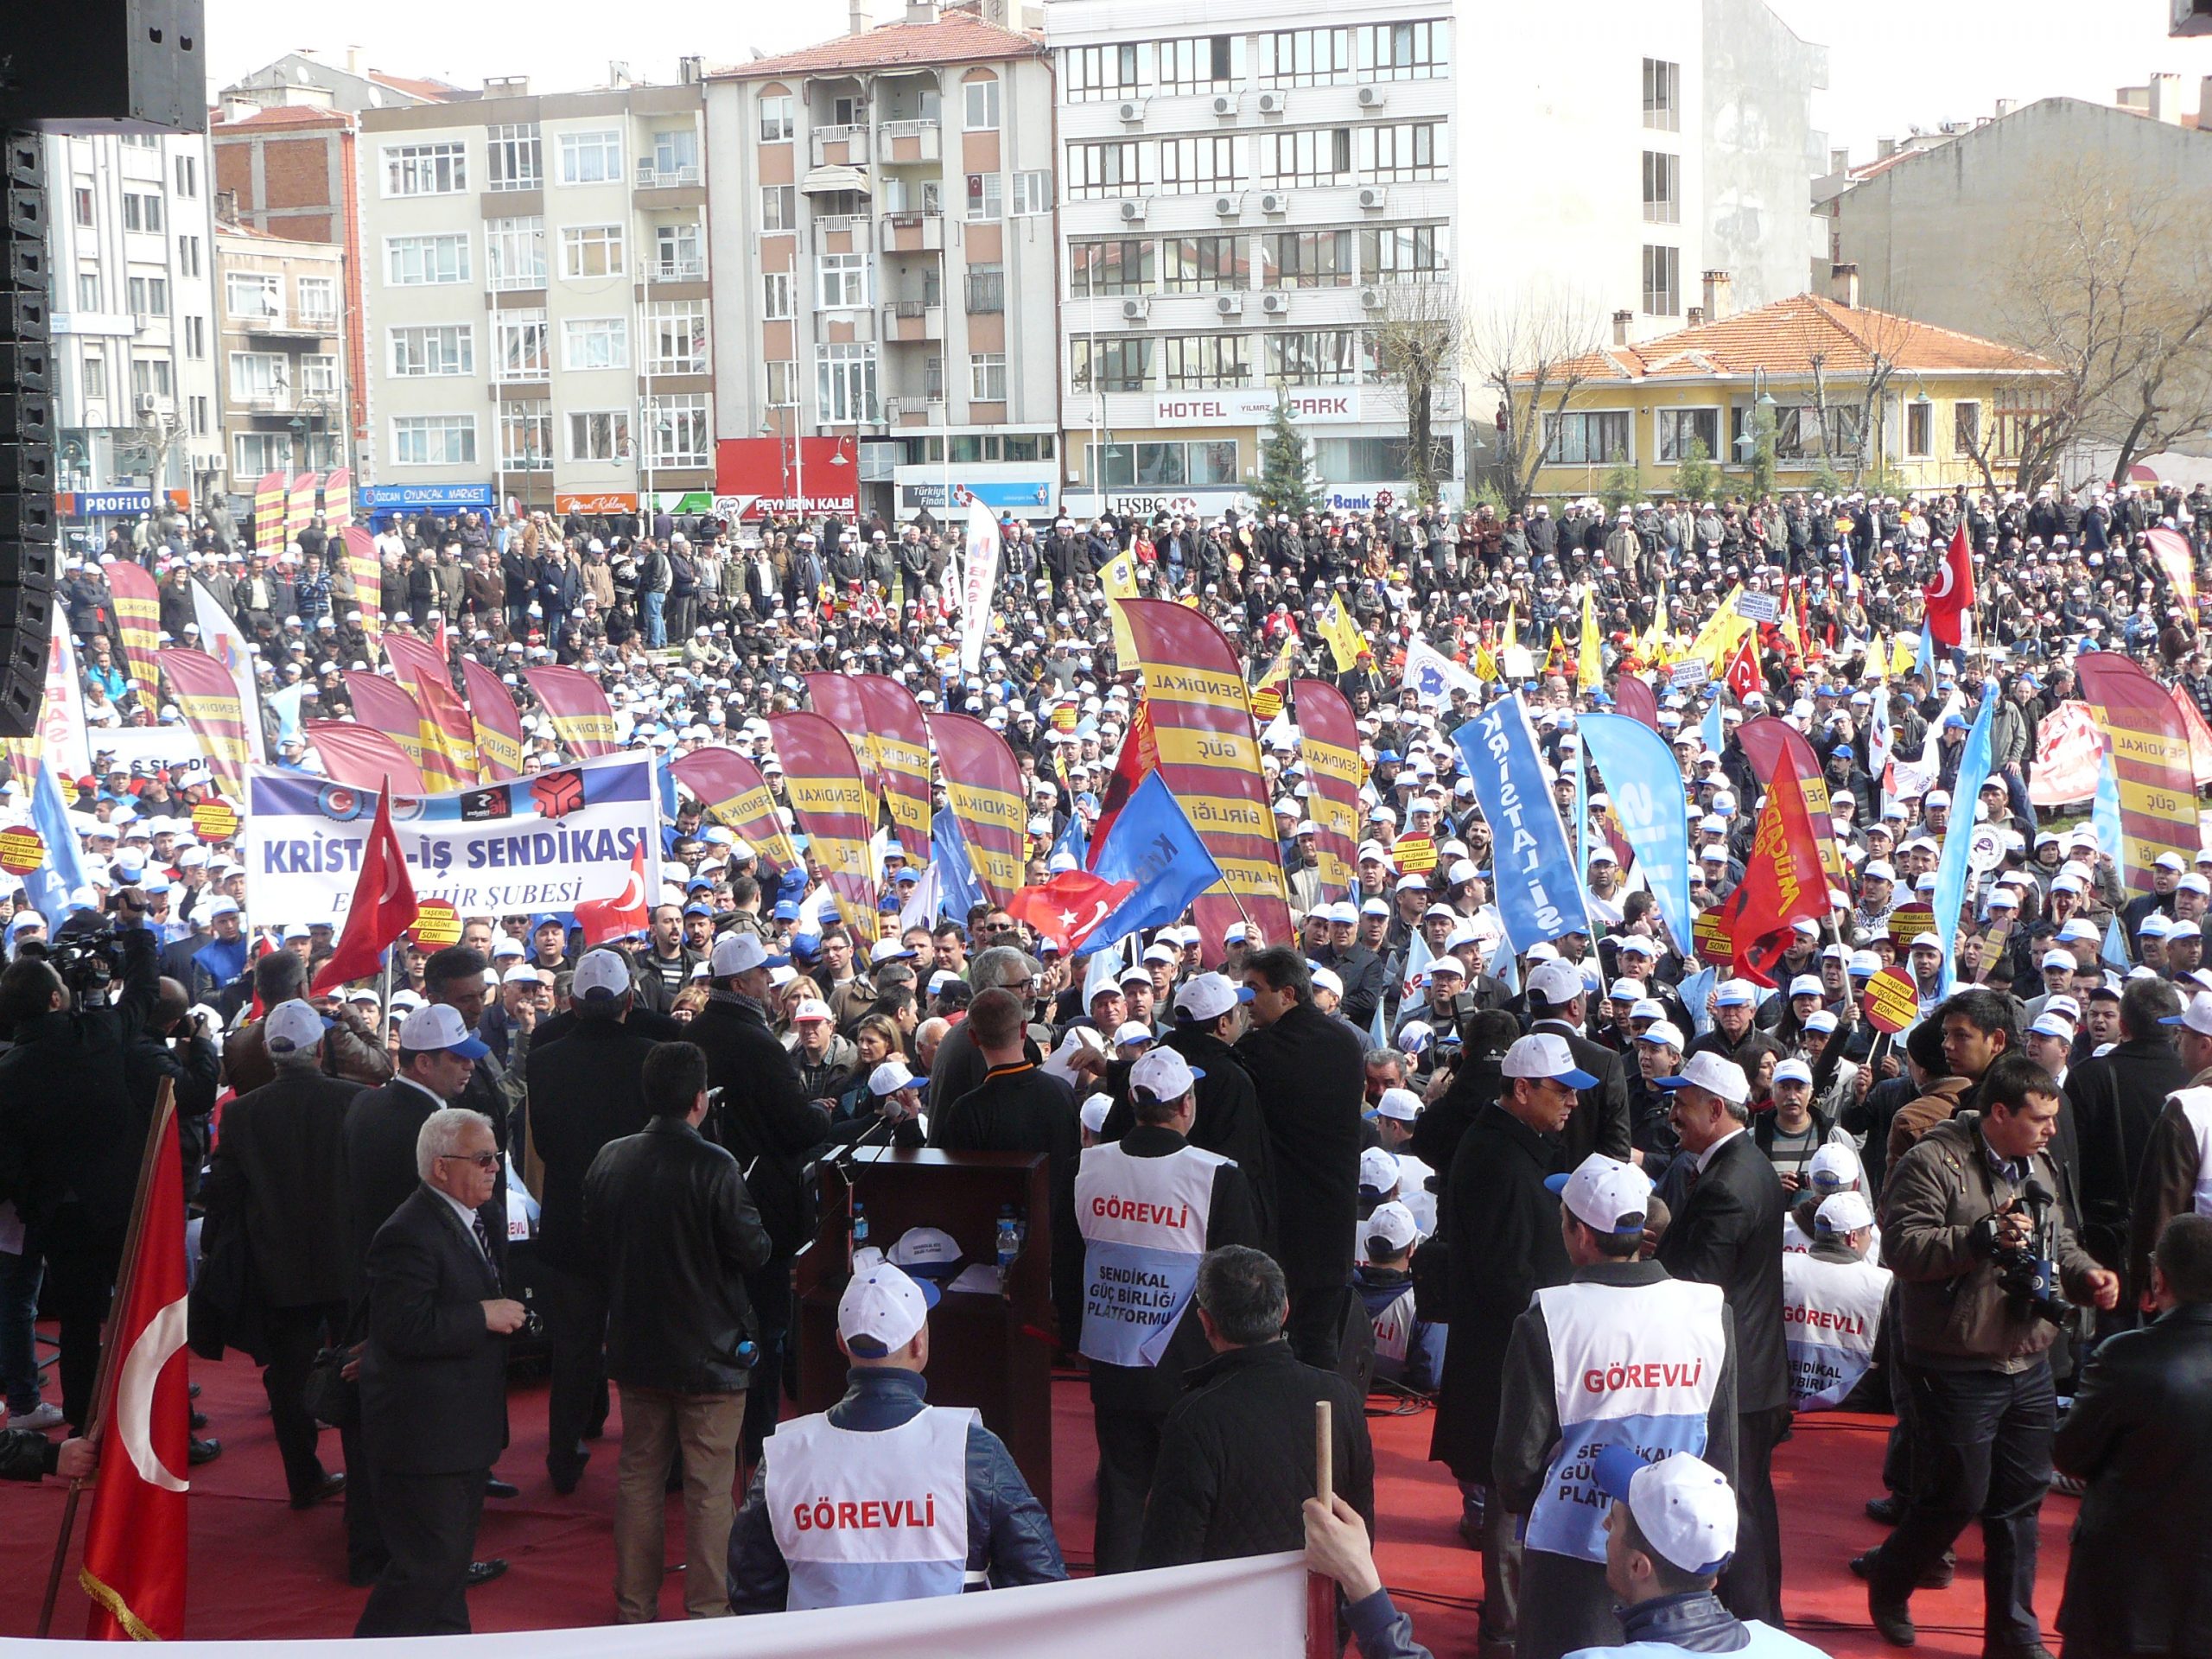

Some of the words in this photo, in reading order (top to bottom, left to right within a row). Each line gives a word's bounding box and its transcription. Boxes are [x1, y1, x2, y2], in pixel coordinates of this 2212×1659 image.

[1159, 402, 1227, 418] HOTEL
[1289, 397, 1349, 415] PARK
[376, 491, 400, 502] ÖZCAN
[404, 488, 443, 500] OYUNCAK
[448, 488, 485, 499] MARKET
[817, 494, 855, 510] KALBİ
[913, 486, 946, 497] Türkiye
[1116, 497, 1167, 514] HSBC
[263, 830, 454, 879] KRİST-İŞ
[467, 821, 648, 869] SENDİKASI
[485, 875, 584, 911] ŞUBESİ
[422, 931, 441, 940] SON!
[1708, 941, 1730, 951] SON!
[1885, 977, 1912, 996] TAŞERON
[1874, 1002, 1894, 1017] SON!
[1091, 1194, 1188, 1230] GÖREVLİ
[1099, 1265, 1170, 1289] SENDİKAL
[1089, 1282, 1115, 1302] GÜÇ
[1117, 1287, 1177, 1308] BİRLİĞİ
[1783, 1305, 1865, 1336] GÖREVLİ
[1583, 1357, 1702, 1394] GÖREVLİ
[792, 1492, 936, 1532] GÖREVLİ
